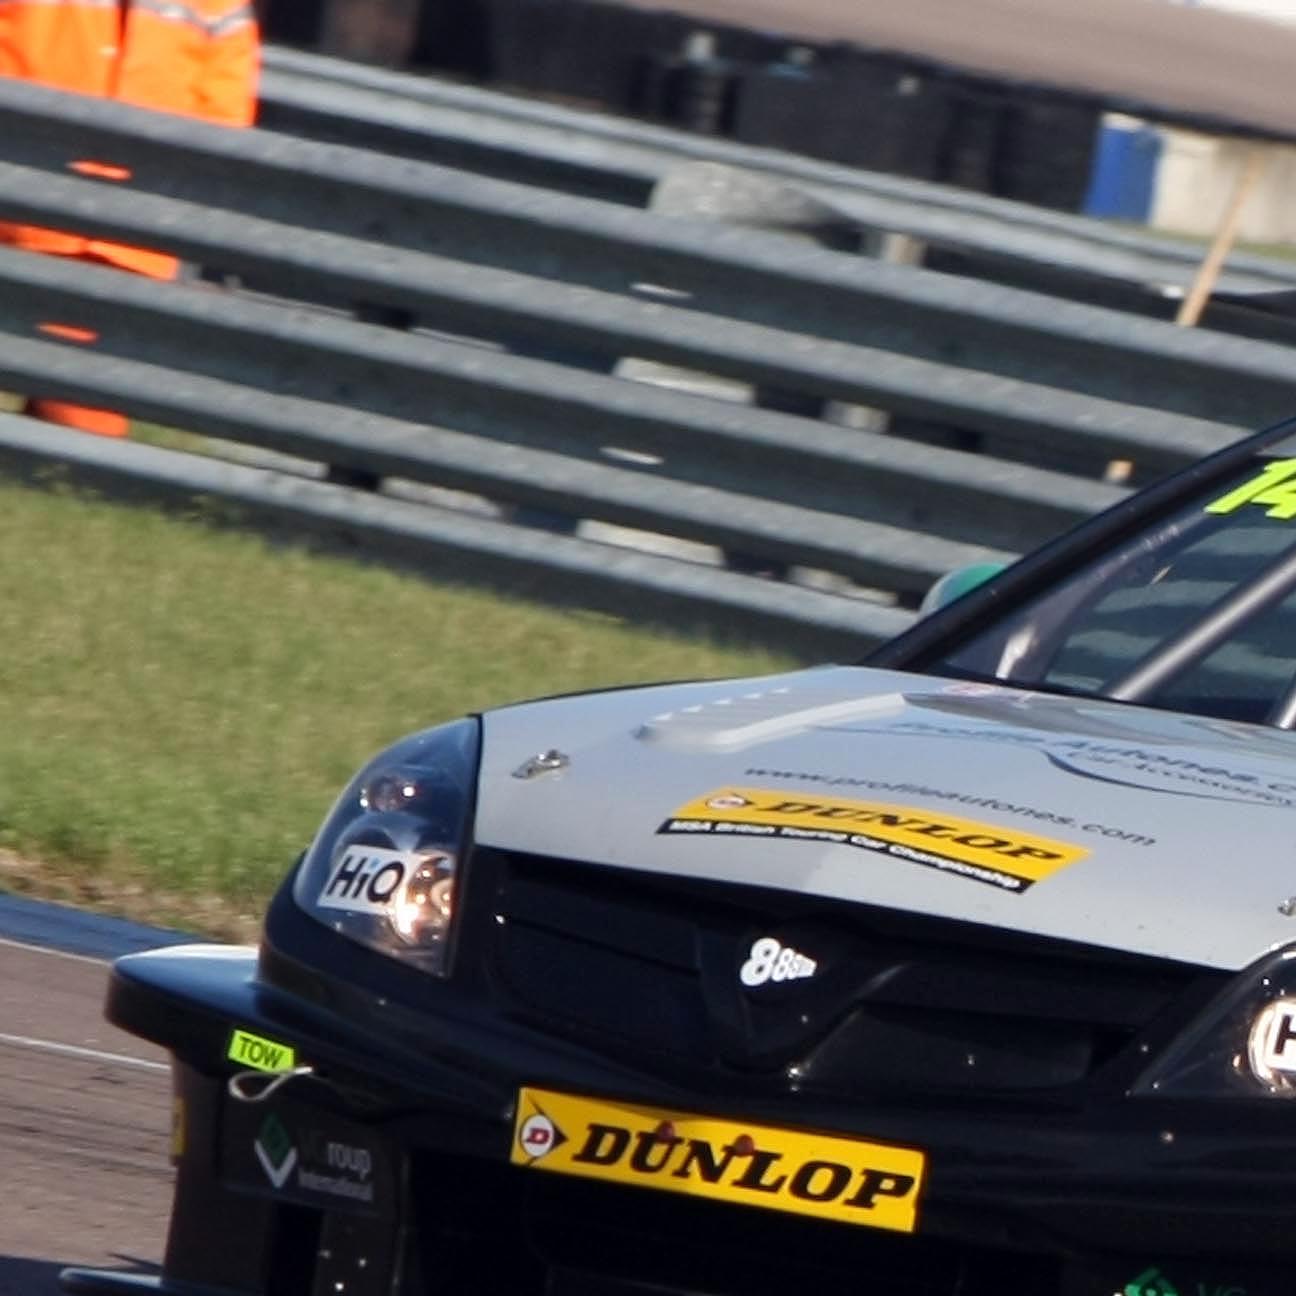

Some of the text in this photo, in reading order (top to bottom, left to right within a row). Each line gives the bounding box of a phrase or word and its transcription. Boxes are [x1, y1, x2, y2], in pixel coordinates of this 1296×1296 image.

[756, 800, 1064, 860] DUNLOP
[326, 854, 406, 904] HiQ
[238, 1036, 285, 1069] TOW
[571, 1123, 916, 1213] DUNLOP
